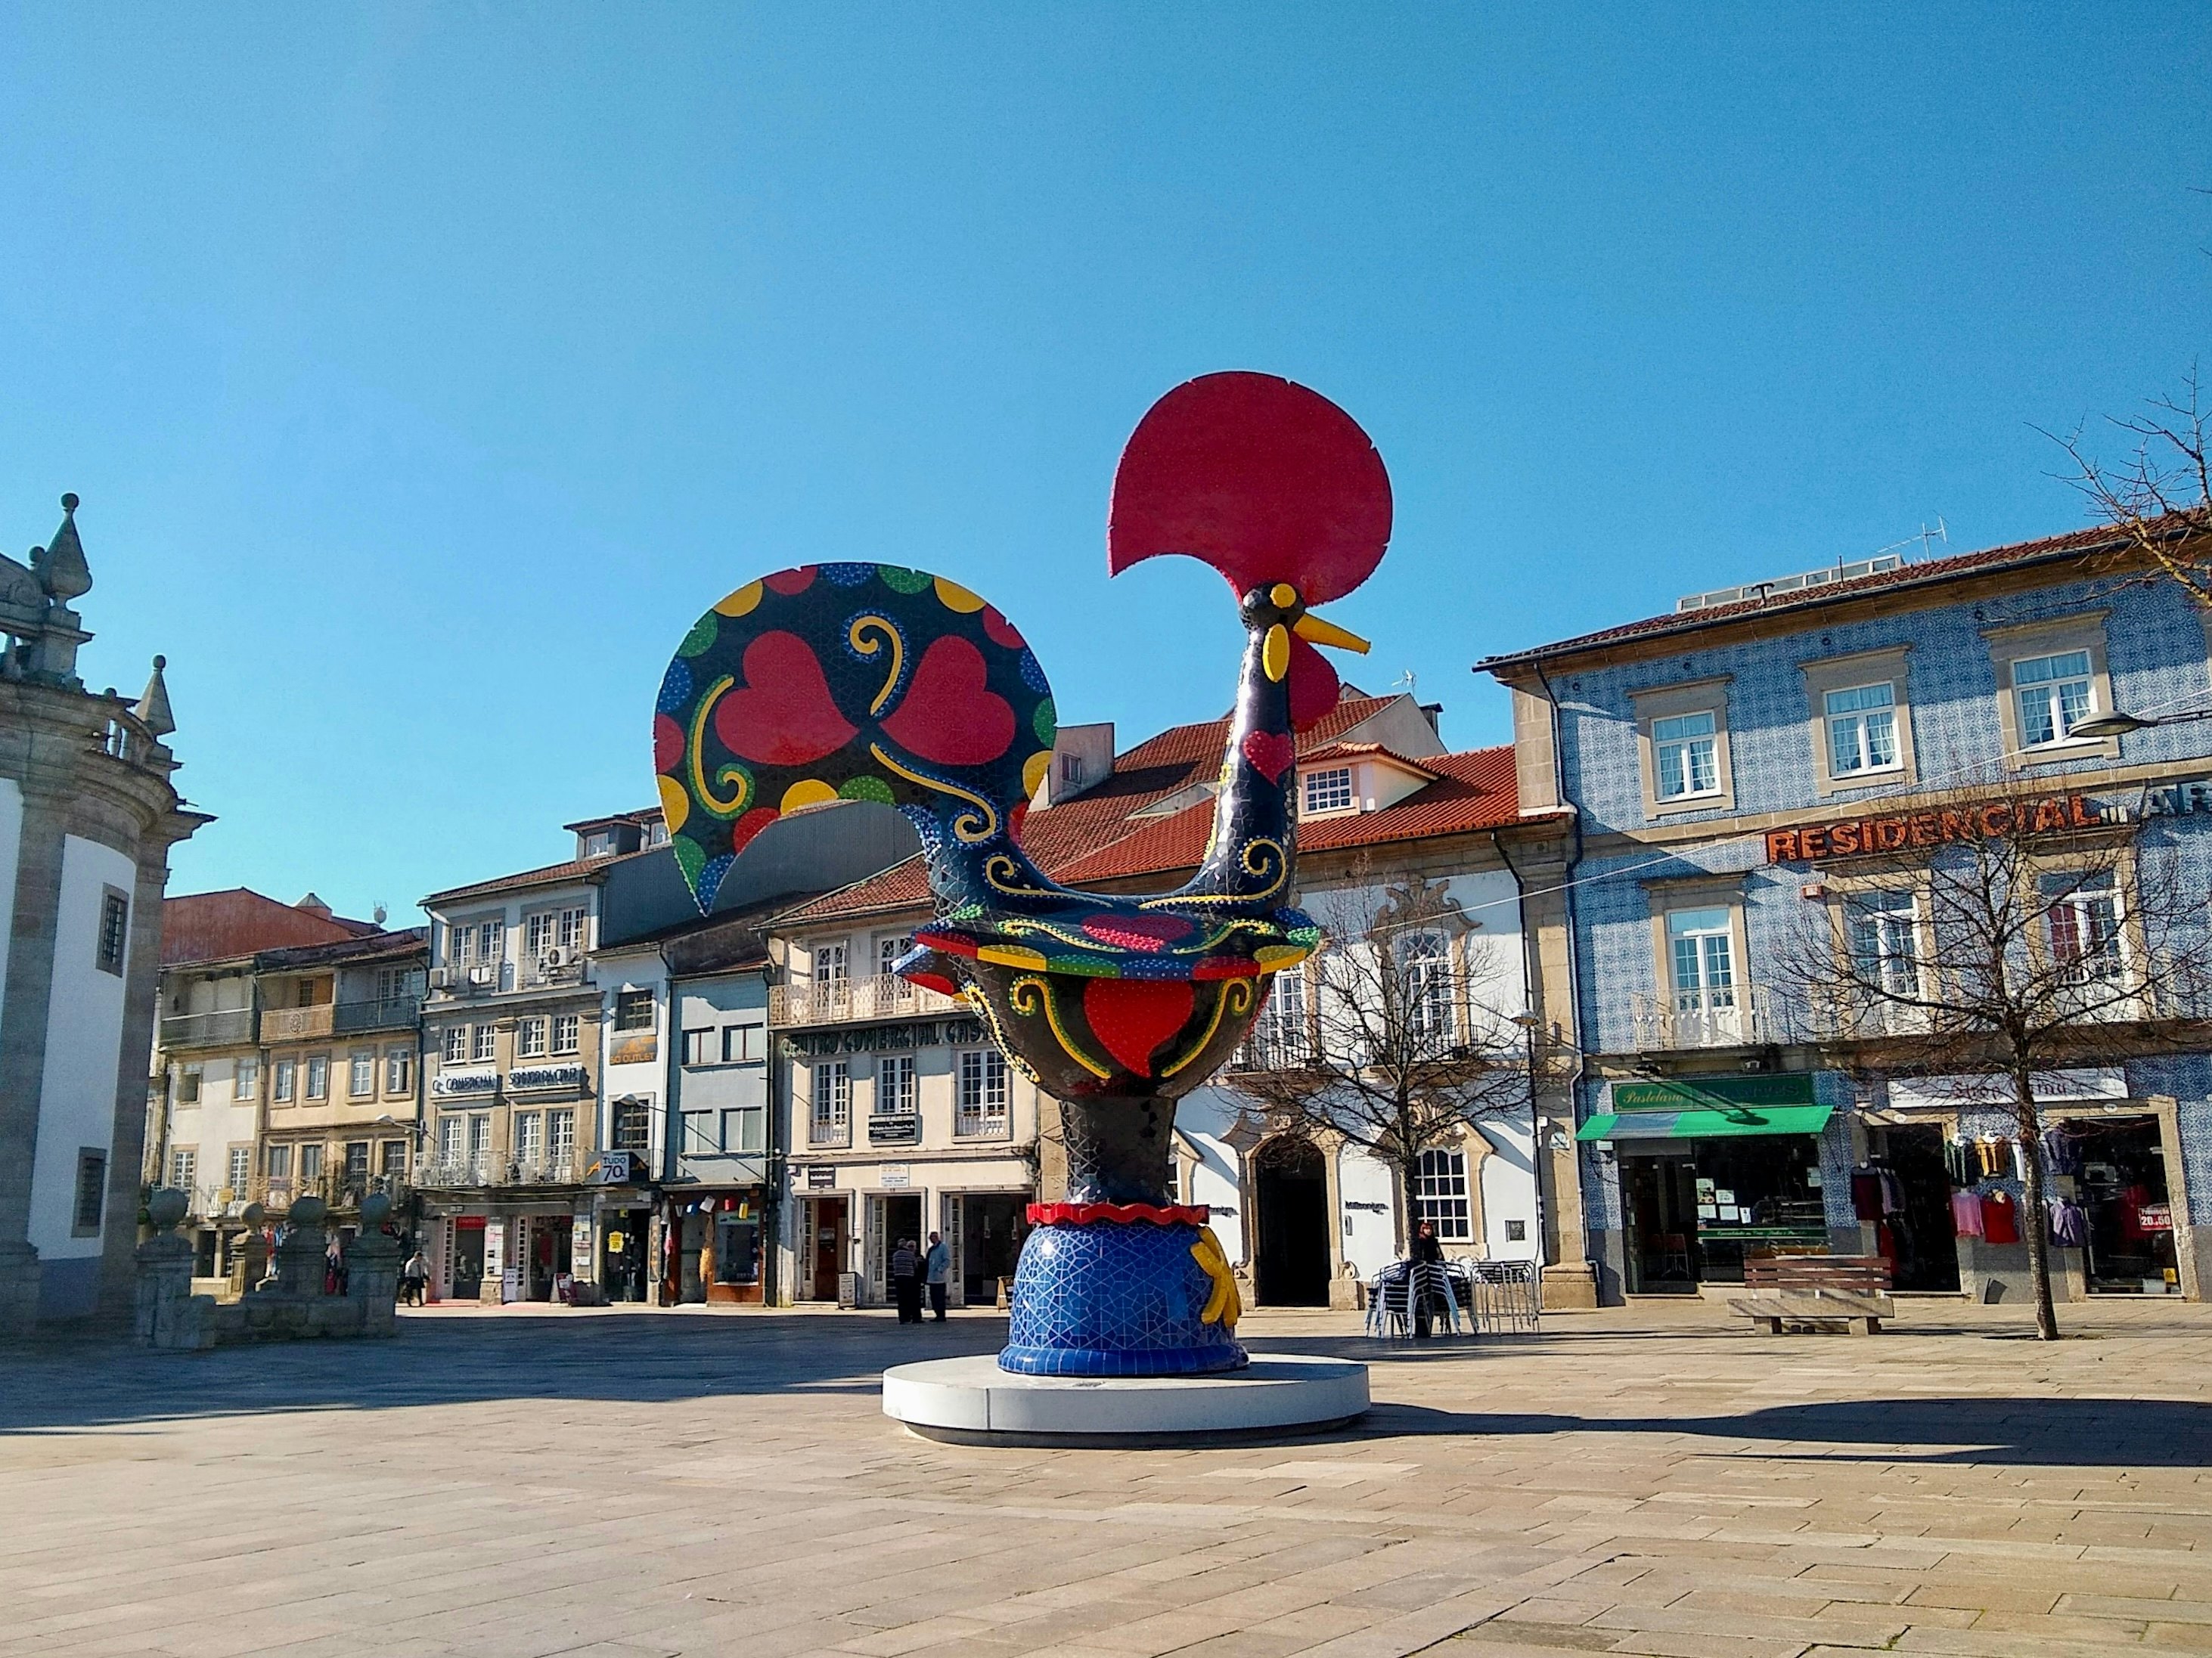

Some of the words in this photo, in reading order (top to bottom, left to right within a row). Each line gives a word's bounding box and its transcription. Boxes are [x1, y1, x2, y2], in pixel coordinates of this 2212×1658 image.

[1766, 794, 2100, 863] RESIDENCIAL
[780, 1031, 840, 1056] CENTRO
[845, 1022, 939, 1052] COMERCIAL
[622, 1052, 655, 1063] OUTLET
[446, 1076, 498, 1092] COMERCIAL
